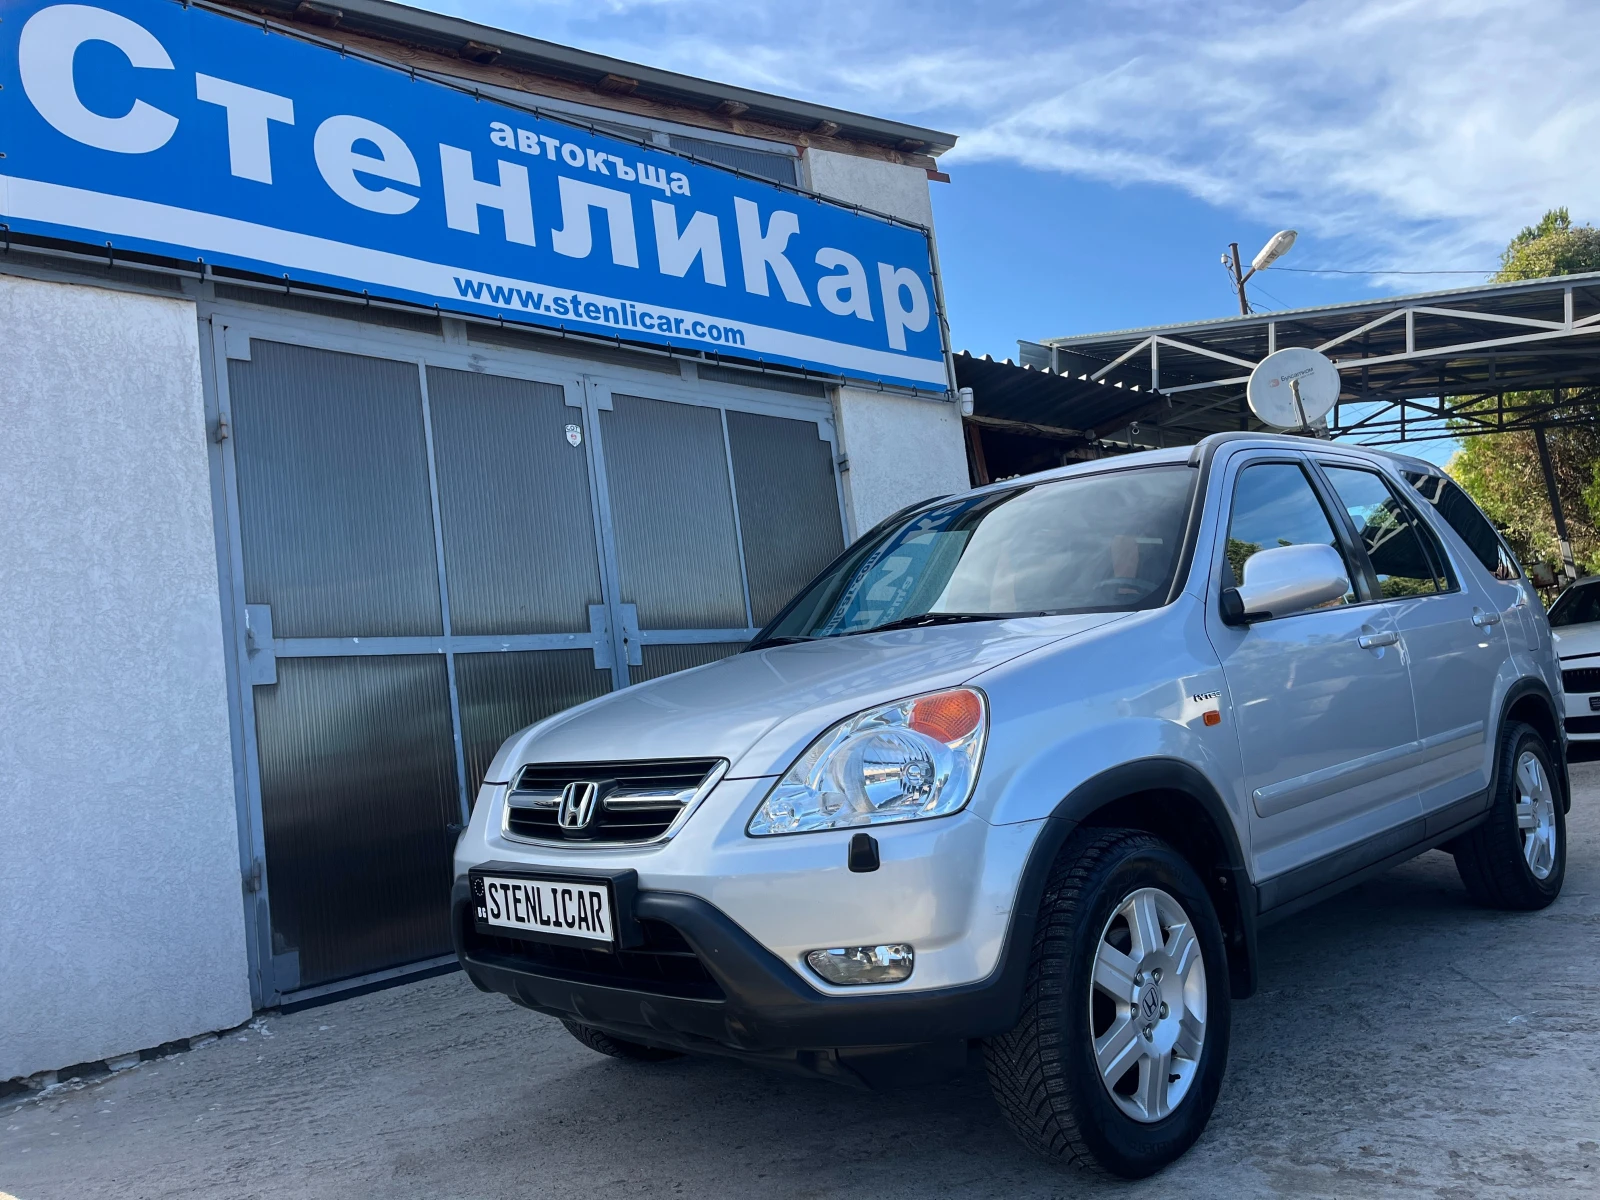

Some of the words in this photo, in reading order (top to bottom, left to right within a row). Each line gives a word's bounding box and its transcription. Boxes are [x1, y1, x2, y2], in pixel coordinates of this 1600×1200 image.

[18, 4, 930, 351] СтенлиКар
[489, 121, 691, 197] автокъща
[453, 276, 746, 346] www.stenlicar.com
[488, 882, 605, 933] STENLICAR
